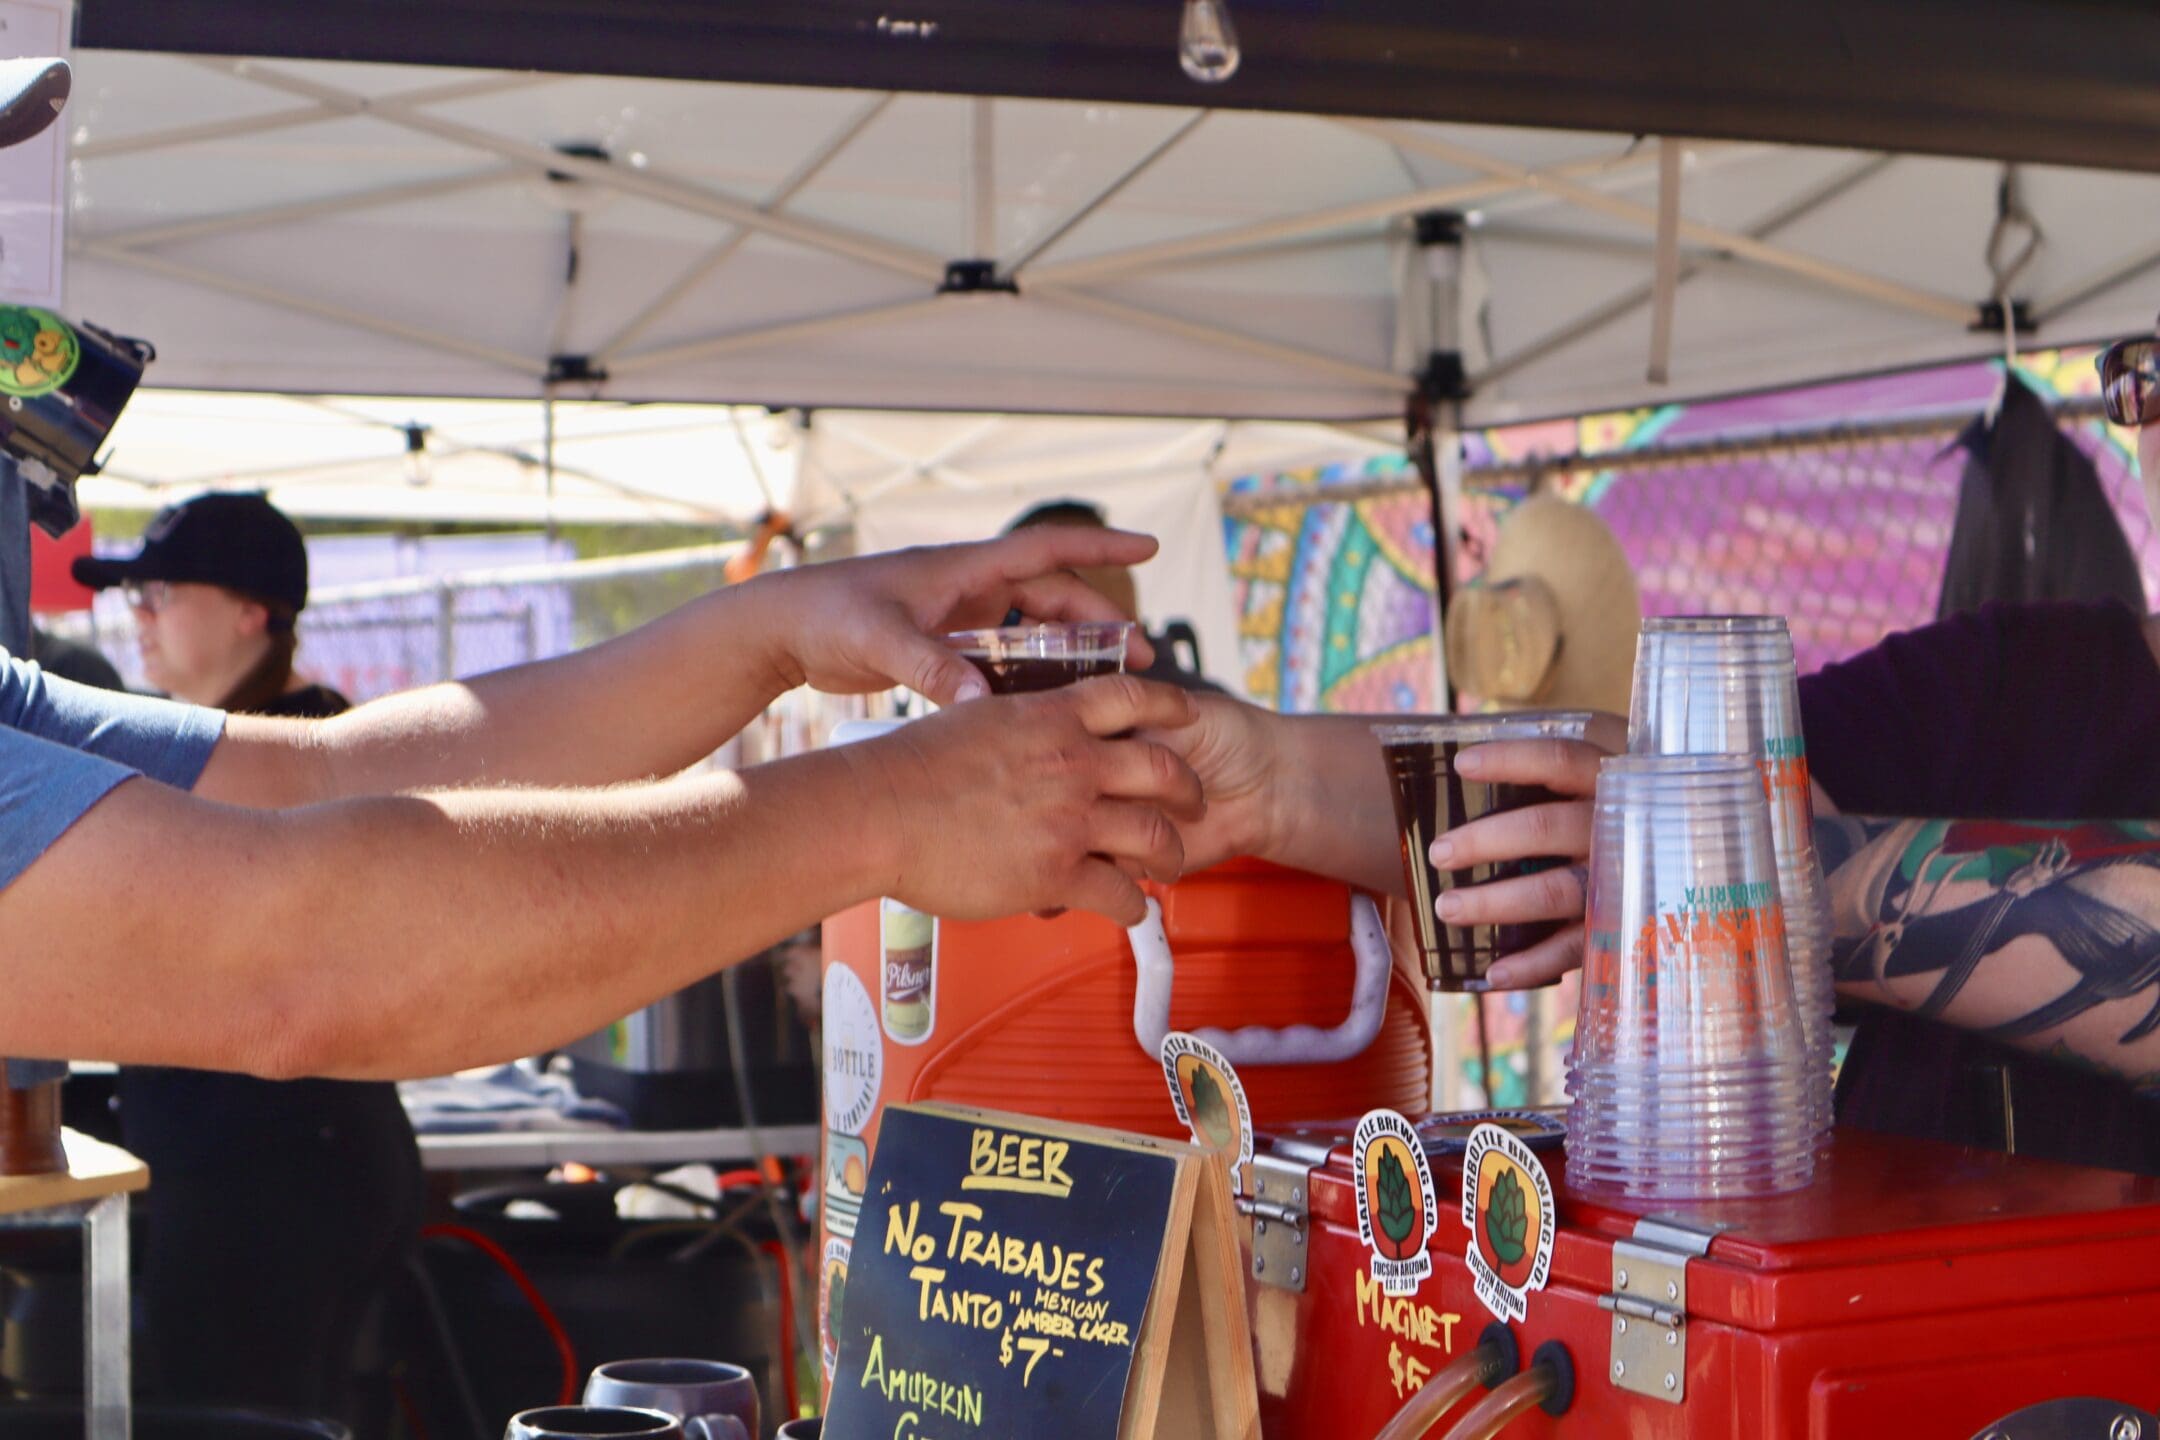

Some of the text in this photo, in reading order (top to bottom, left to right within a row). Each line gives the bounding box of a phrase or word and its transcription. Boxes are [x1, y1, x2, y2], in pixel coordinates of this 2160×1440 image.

[1163, 1036, 1189, 1121] HARBOTTLE
[1191, 1040, 1250, 1122] BREWING
[969, 1127, 1074, 1187] BEER
[1355, 1116, 1436, 1239] HARBOTTLE BREWING CO.
[1465, 1129, 1552, 1285] HARBOTTLE BREWING CO.
[1373, 1256, 1429, 1276] TUCSON ARIZONA
[1468, 1249, 1525, 1317] TUCSON ARIZONA
[1012, 1307, 1130, 1347] AMBER LAGER
[1034, 1287, 1110, 1320] MEXICAN
[1355, 1267, 1461, 1355] MAGNET
[1388, 1341, 1431, 1400] $5
